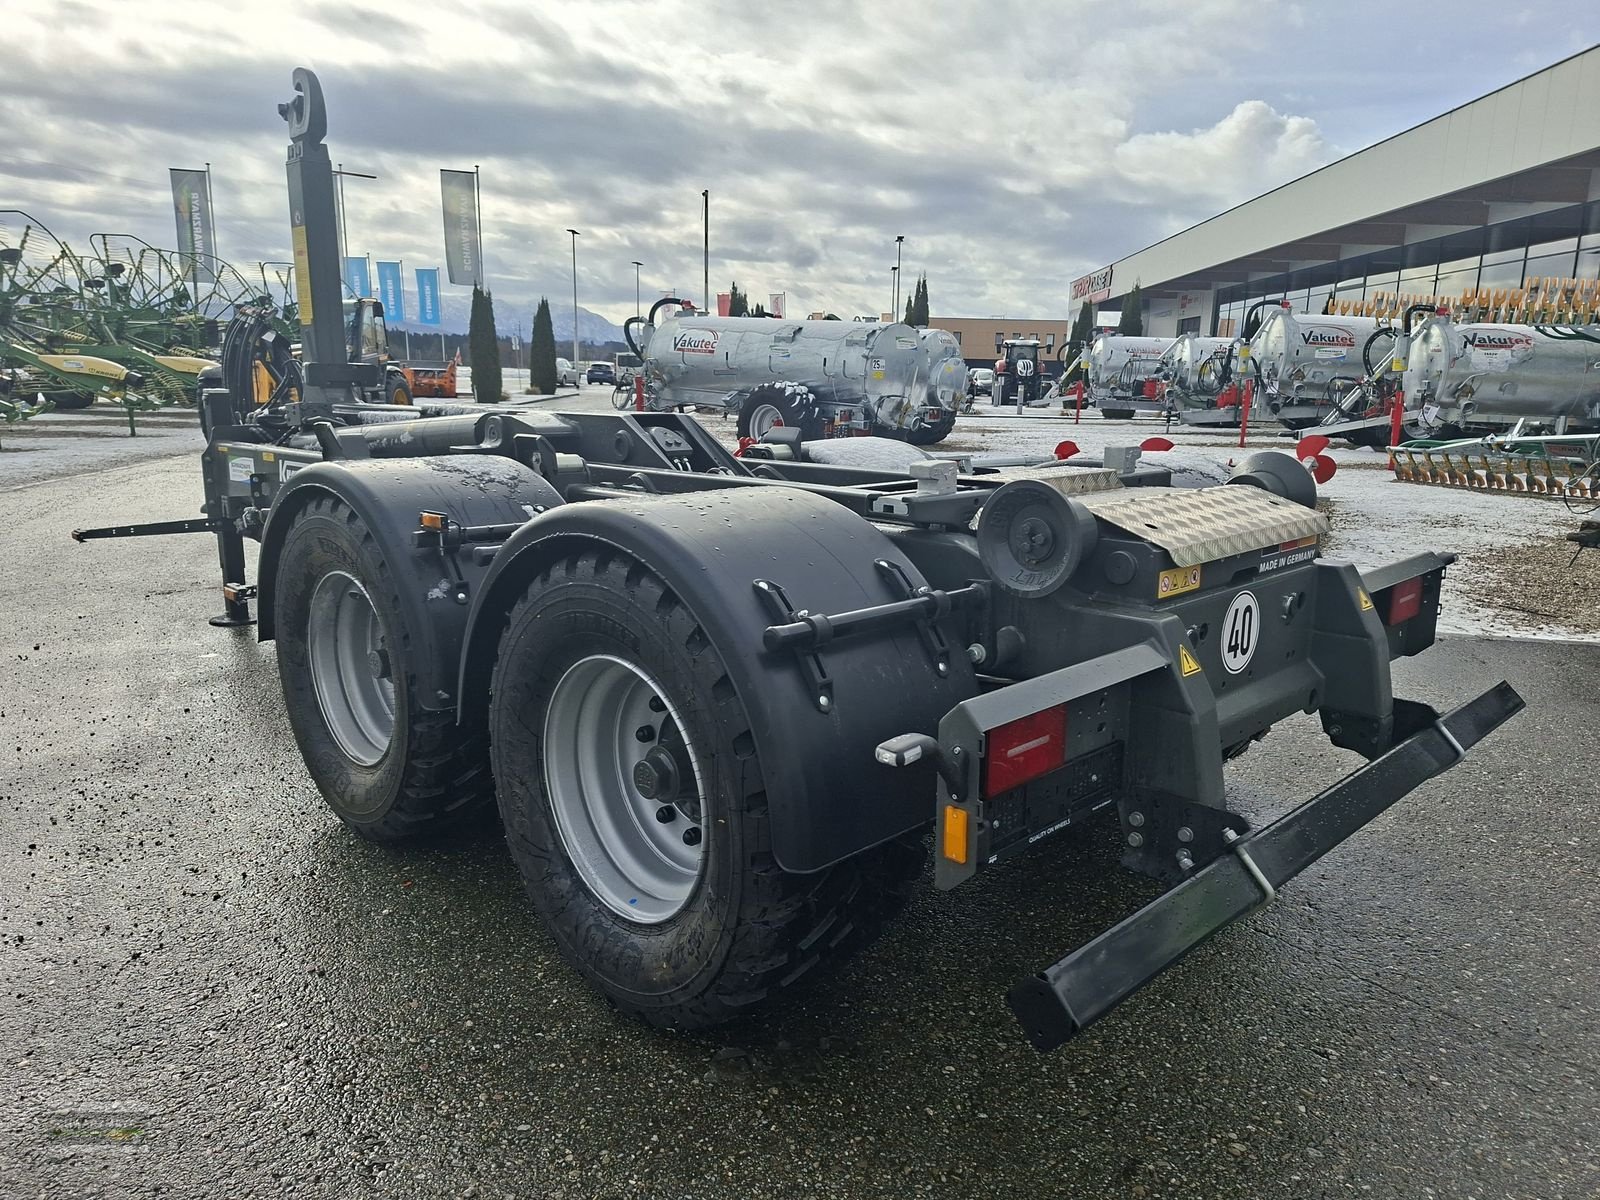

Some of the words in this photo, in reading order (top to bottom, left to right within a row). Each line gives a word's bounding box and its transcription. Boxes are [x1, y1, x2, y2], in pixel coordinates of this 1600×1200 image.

[673, 333, 718, 351] Vakutec
[1300, 330, 1356, 345] Vakutec
[1463, 332, 1533, 347] Vakutec
[873, 359, 881, 370] 25
[1259, 559, 1278, 573] MADE
[1278, 556, 1287, 568] IN
[1286, 549, 1316, 565] GERMANY
[1227, 604, 1253, 659] 40
[1028, 830, 1047, 843] QUALITY
